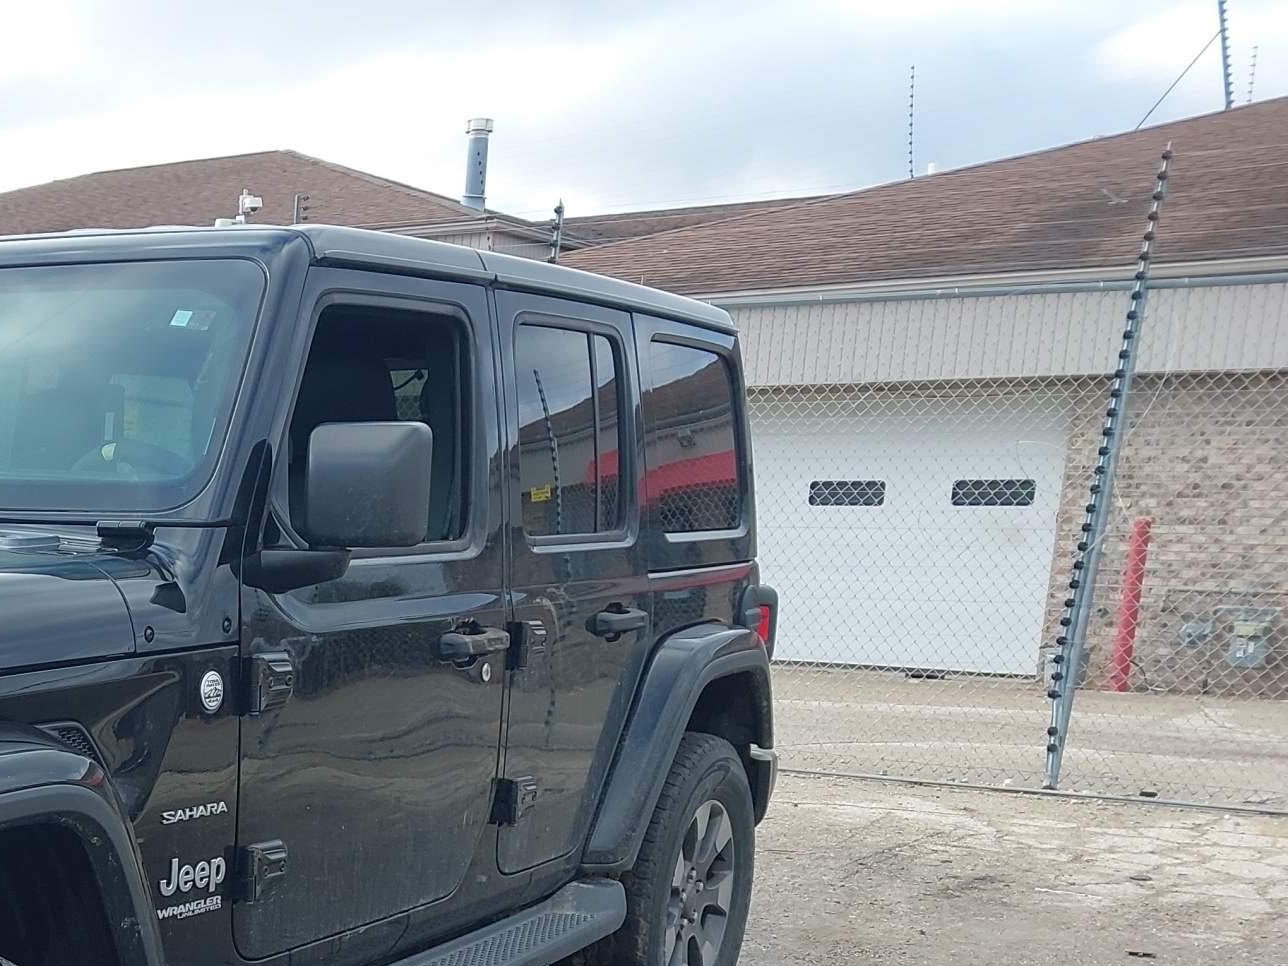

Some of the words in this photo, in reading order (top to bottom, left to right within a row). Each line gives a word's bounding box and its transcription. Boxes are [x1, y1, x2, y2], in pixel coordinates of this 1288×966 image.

[161, 801, 228, 825] SAHARA
[160, 856, 226, 897] Jeep
[156, 895, 222, 920] WRANGLER
[177, 903, 222, 920] UNLIMITED
